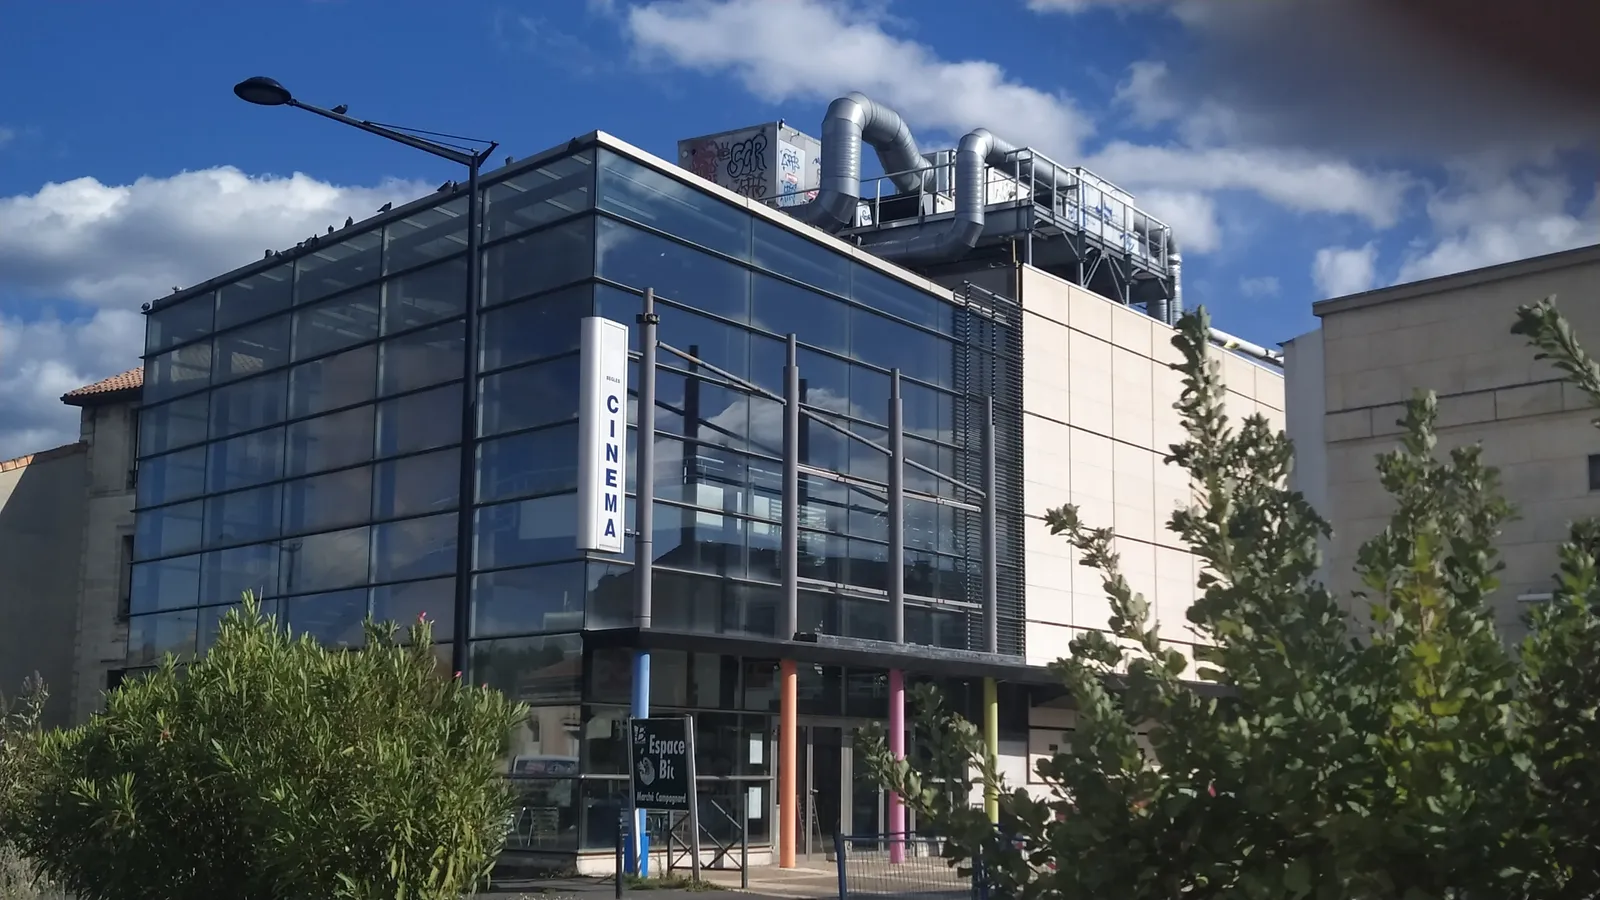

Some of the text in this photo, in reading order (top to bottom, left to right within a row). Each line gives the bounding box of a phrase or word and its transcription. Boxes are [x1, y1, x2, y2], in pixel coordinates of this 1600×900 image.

[604, 394, 619, 538] CINEMA
[649, 734, 685, 759] Espace
[655, 791, 686, 805] Campagnard
